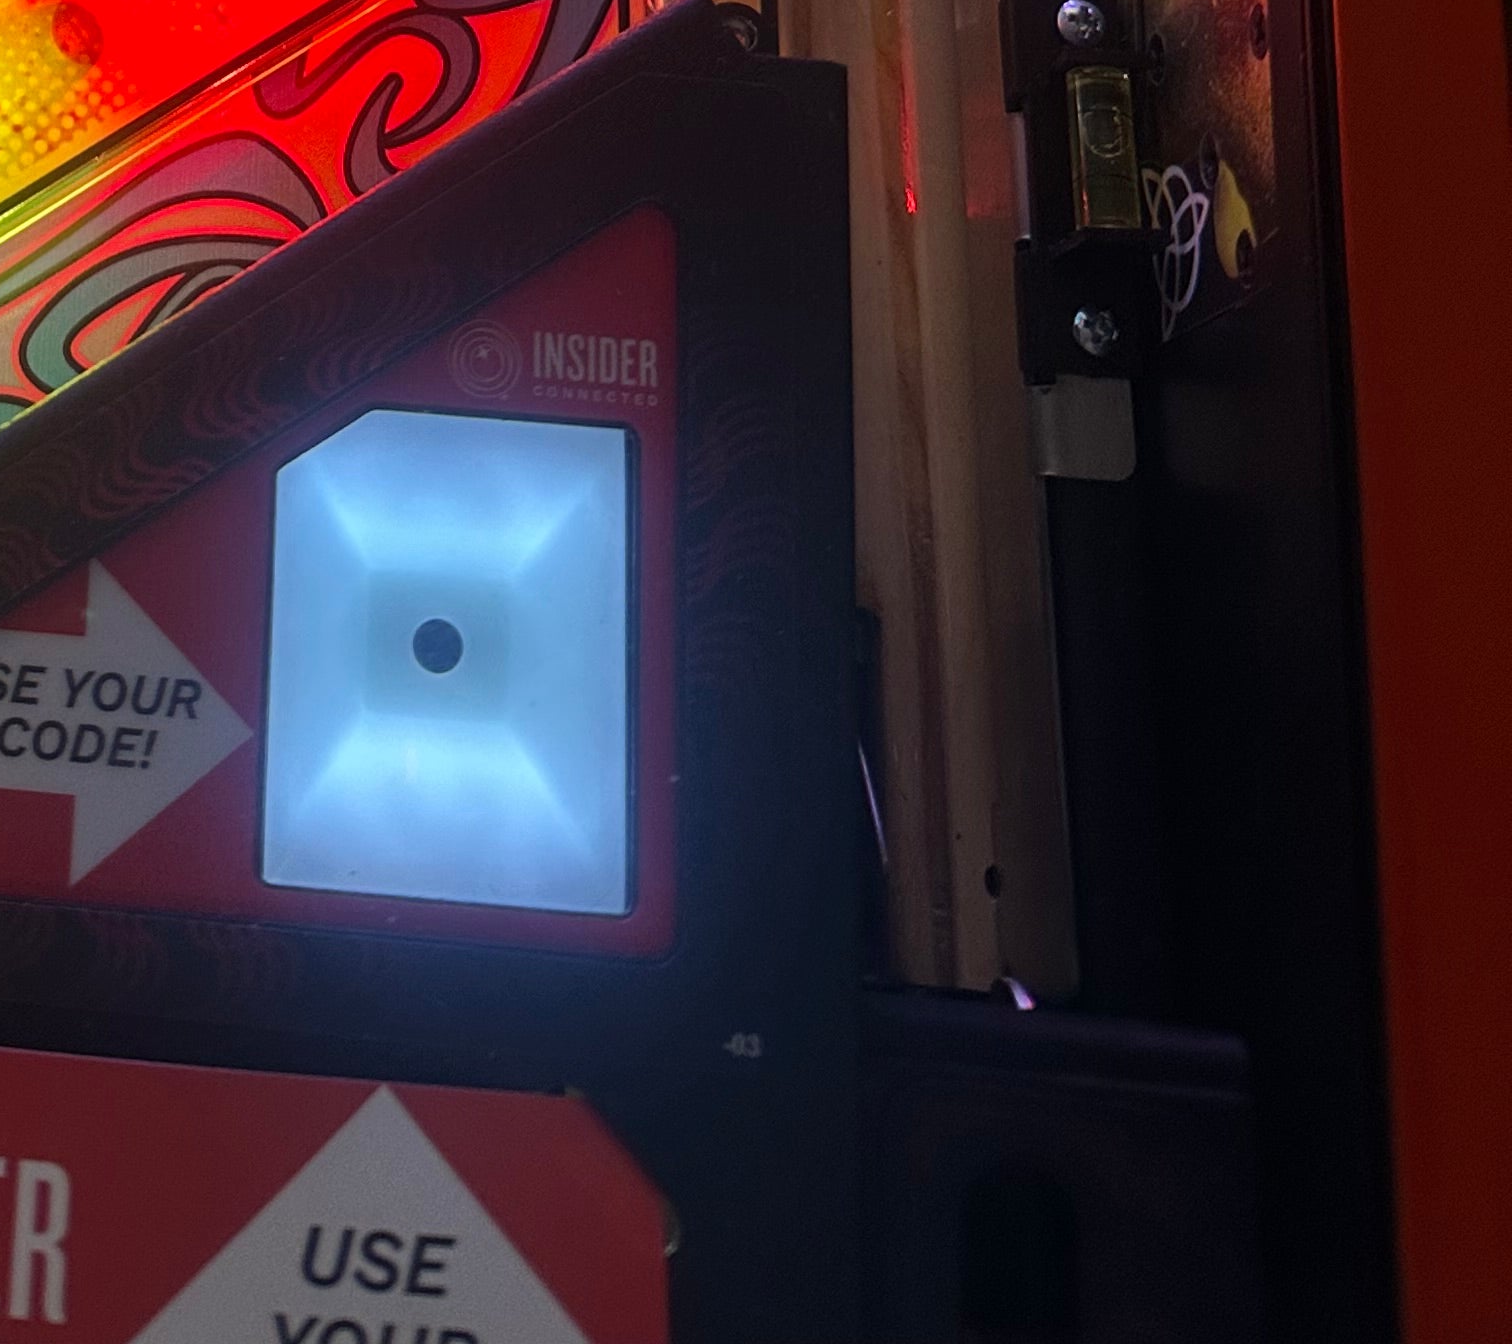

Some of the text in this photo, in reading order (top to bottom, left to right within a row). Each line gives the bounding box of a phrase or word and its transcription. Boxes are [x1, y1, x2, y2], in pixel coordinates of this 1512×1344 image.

[533, 331, 659, 388] INSIDER
[532, 385, 659, 407] CONNECTED
[64, 668, 202, 720] YOUR
[300, 1225, 458, 1298] USE
